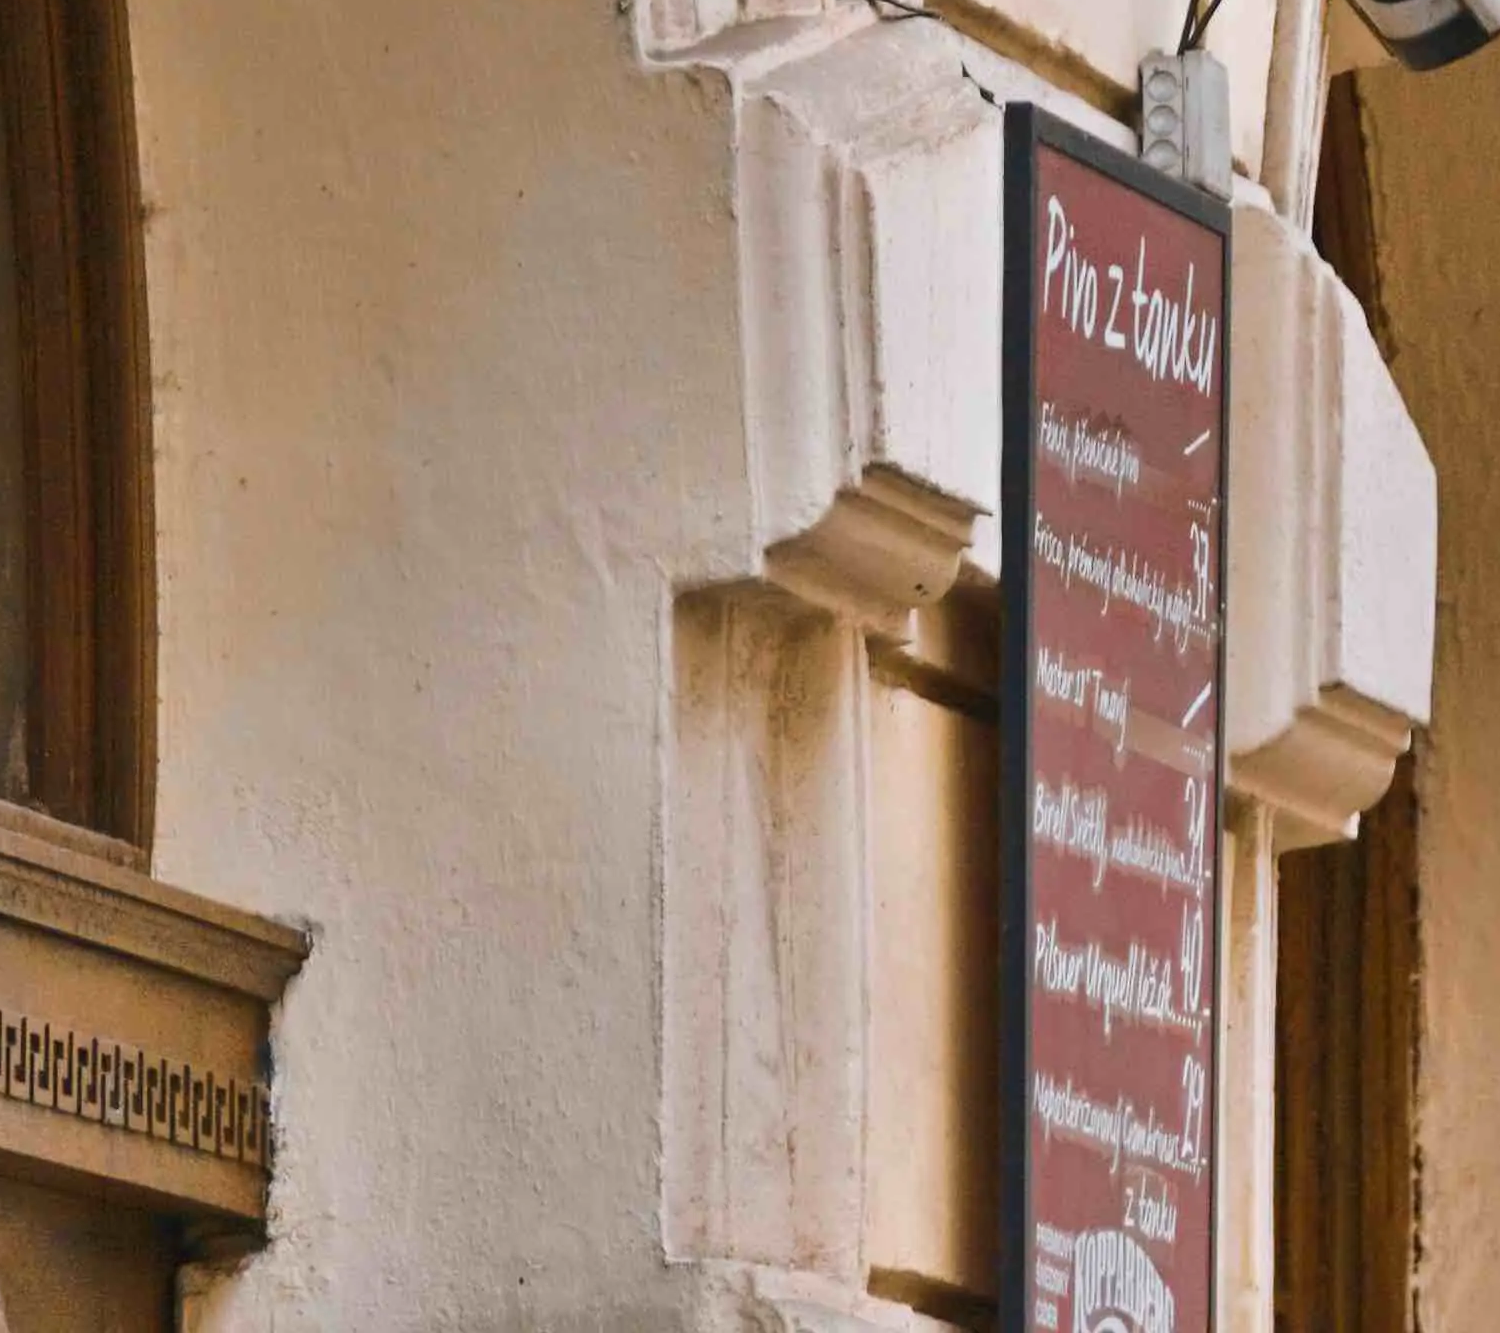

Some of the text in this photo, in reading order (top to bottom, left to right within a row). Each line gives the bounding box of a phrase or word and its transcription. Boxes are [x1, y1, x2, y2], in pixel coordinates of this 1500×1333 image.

[1044, 194, 1217, 397] Pivo z tanku
[1035, 920, 1083, 991] Pilsner
[1086, 943, 1137, 1035] Urquell
[1123, 1172, 1177, 1242] z tanku
